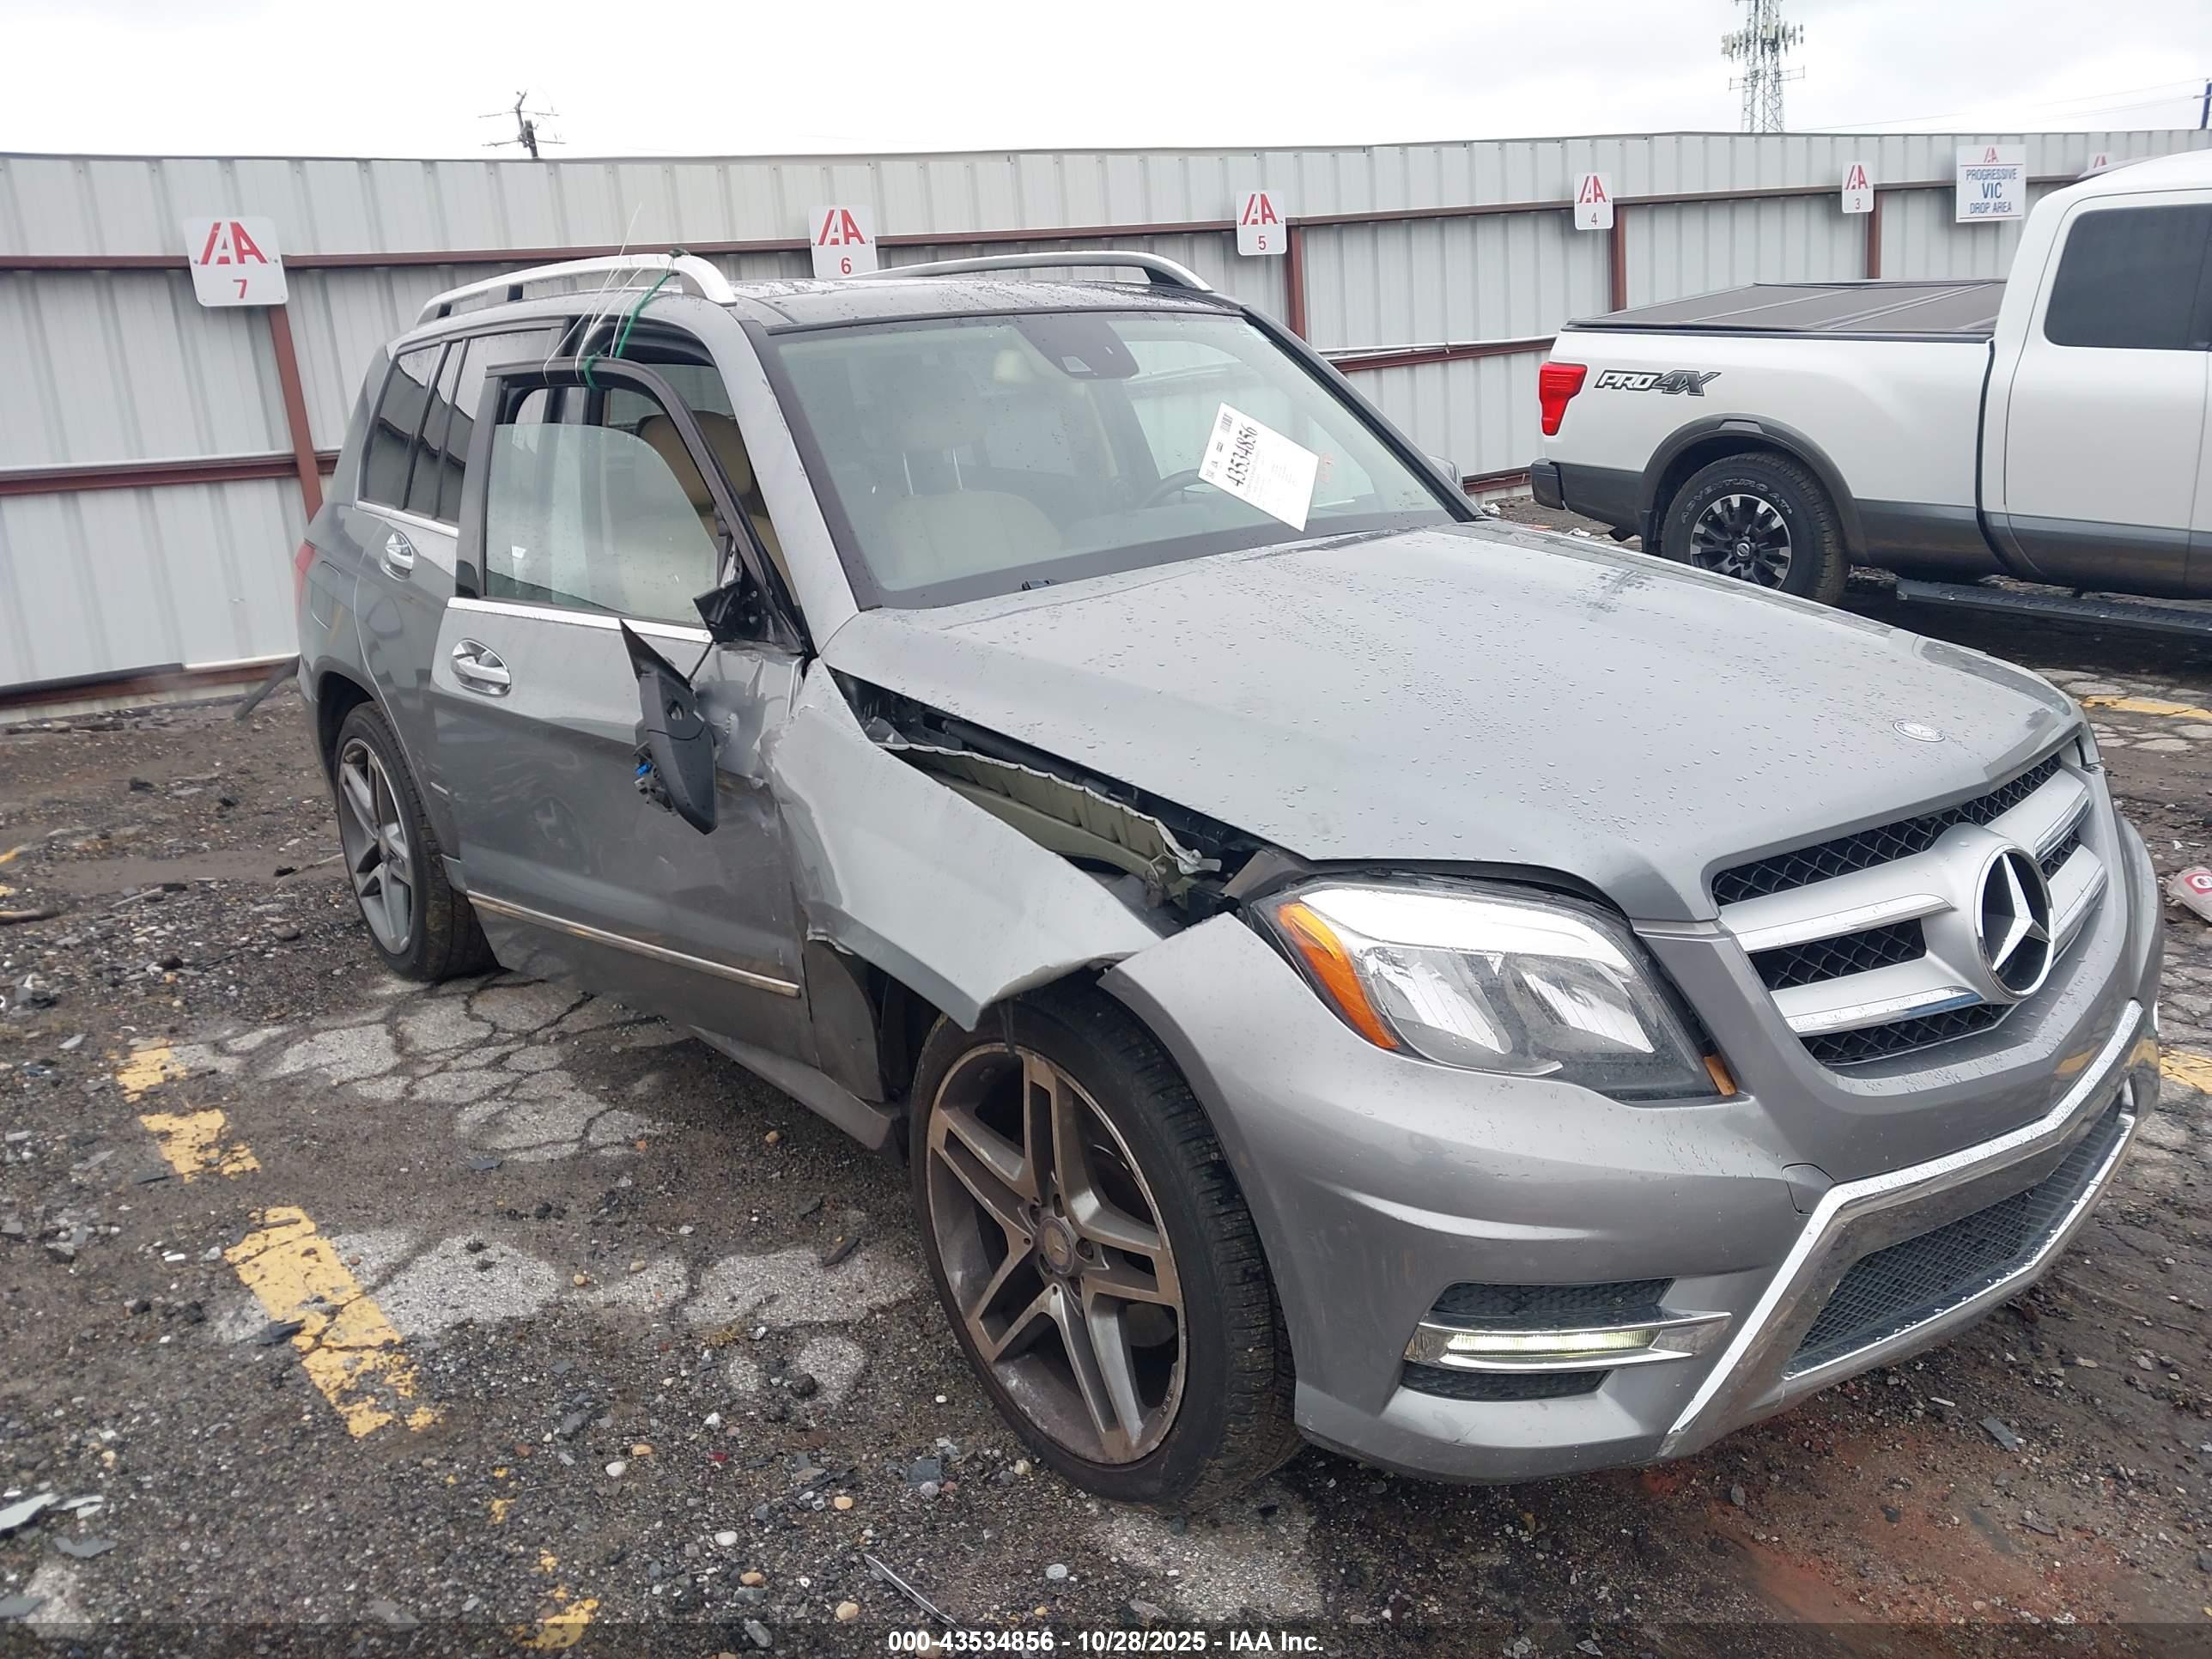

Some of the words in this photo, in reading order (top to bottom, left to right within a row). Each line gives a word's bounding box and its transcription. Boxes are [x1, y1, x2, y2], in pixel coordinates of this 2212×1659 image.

[1966, 168, 2017, 180] PROGRESSIVE
[1982, 182, 2002, 198] VIC
[1855, 198, 1861, 210] 3
[1970, 203, 1990, 214] DROP
[1992, 202, 2012, 213] AREA
[1591, 212, 1598, 225] 4
[1258, 235, 1267, 251] 5
[841, 257, 852, 275] 6
[233, 279, 247, 299] 7
[1225, 422, 1259, 487] 43534856
[1681, 478, 1768, 524] ADVENTURO
